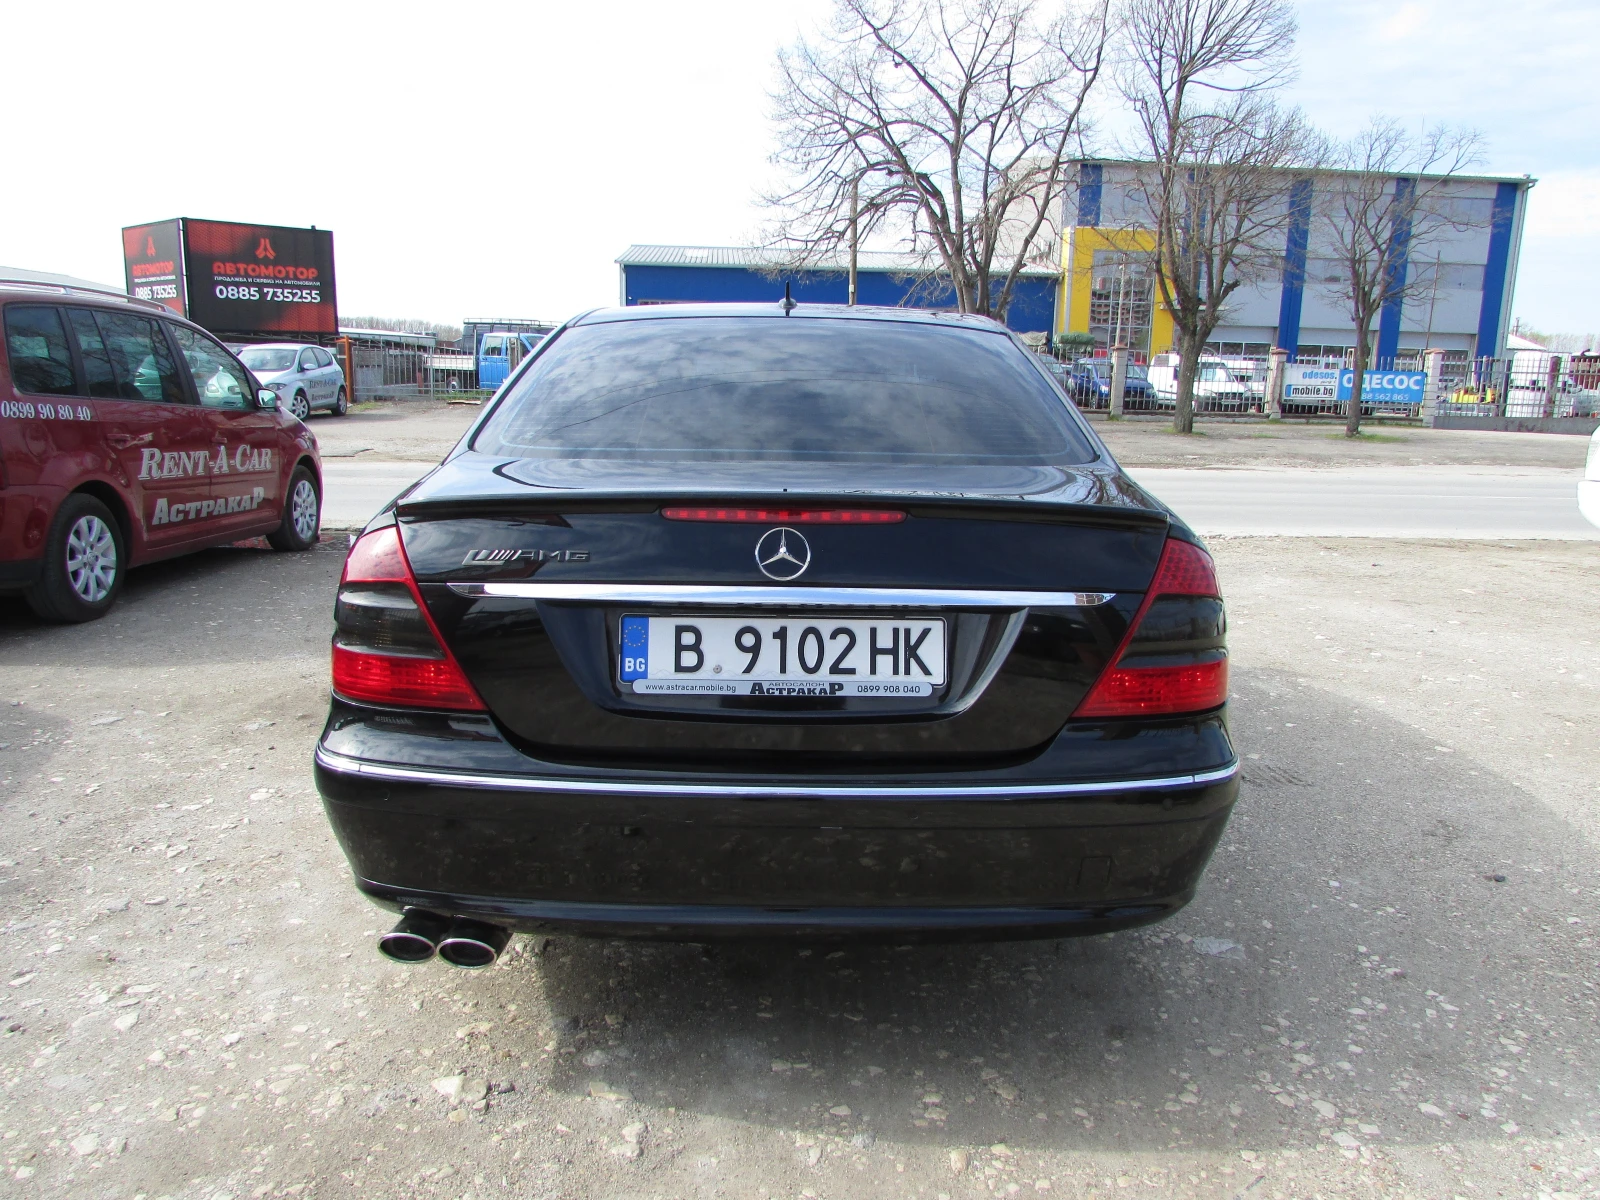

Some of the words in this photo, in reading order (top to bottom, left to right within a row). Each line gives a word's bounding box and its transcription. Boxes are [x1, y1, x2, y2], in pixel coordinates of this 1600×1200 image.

[212, 261, 318, 279] АВТОМОТОР
[152, 284, 177, 299] 735255
[215, 285, 260, 300] 0885
[263, 287, 321, 303] 735255
[1292, 386, 1334, 397] mobile.bg
[1, 400, 35, 419] 0899
[38, 403, 55, 419] 90
[57, 404, 74, 420] 80
[76, 405, 91, 421] 40
[137, 444, 272, 480] RENT-A-CAR
[674, 625, 705, 673] B
[734, 625, 857, 675] 9102
[869, 627, 933, 676] HK
[624, 657, 646, 672] BG
[645, 683, 737, 693] www.astracar.mobile.bg
[857, 685, 880, 694] 0899
[883, 685, 900, 694] 908
[902, 685, 921, 694] 040
